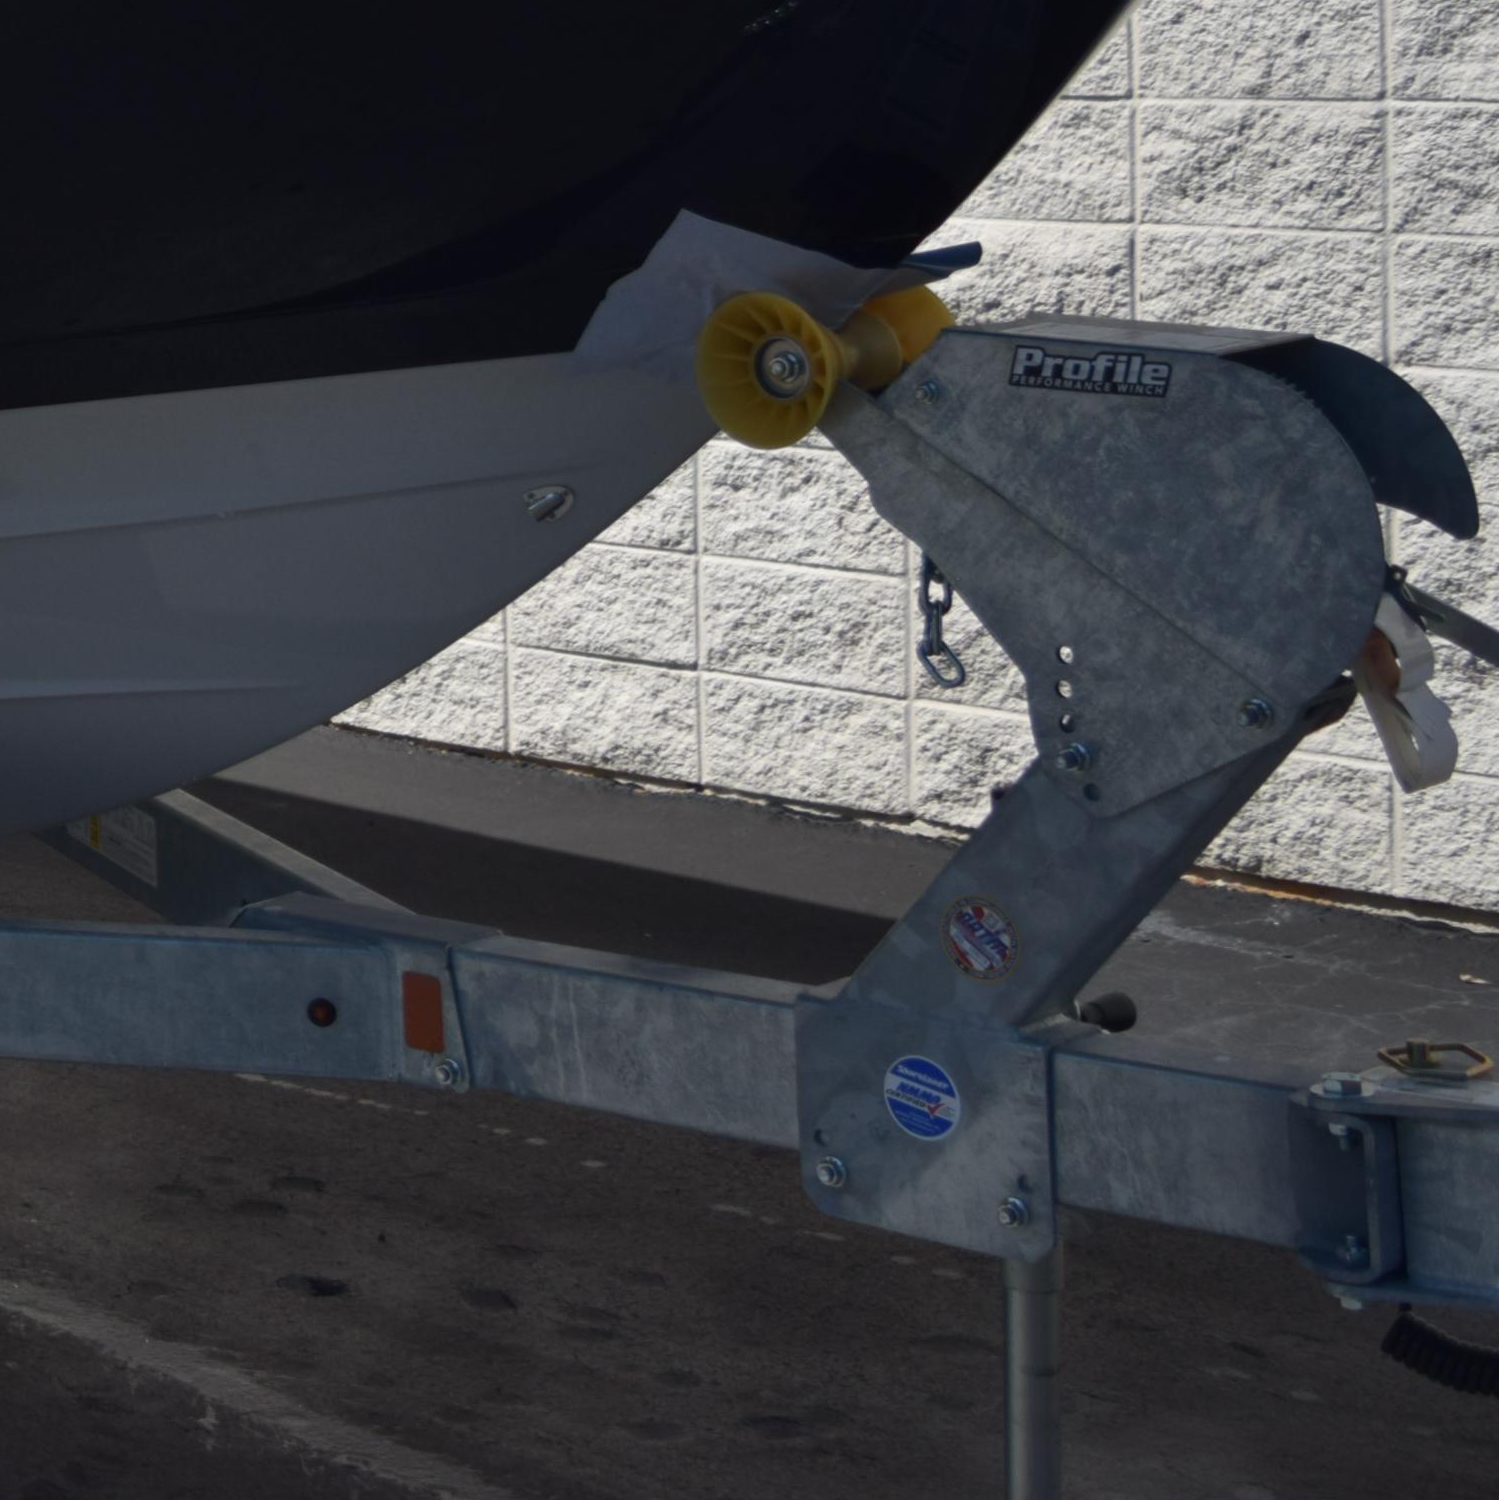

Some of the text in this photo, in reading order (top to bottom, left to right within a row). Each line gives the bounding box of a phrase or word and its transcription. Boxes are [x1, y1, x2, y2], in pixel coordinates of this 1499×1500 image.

[1012, 346, 1172, 386] Profile
[1010, 374, 1165, 396] PERFORMANCE WINCH
